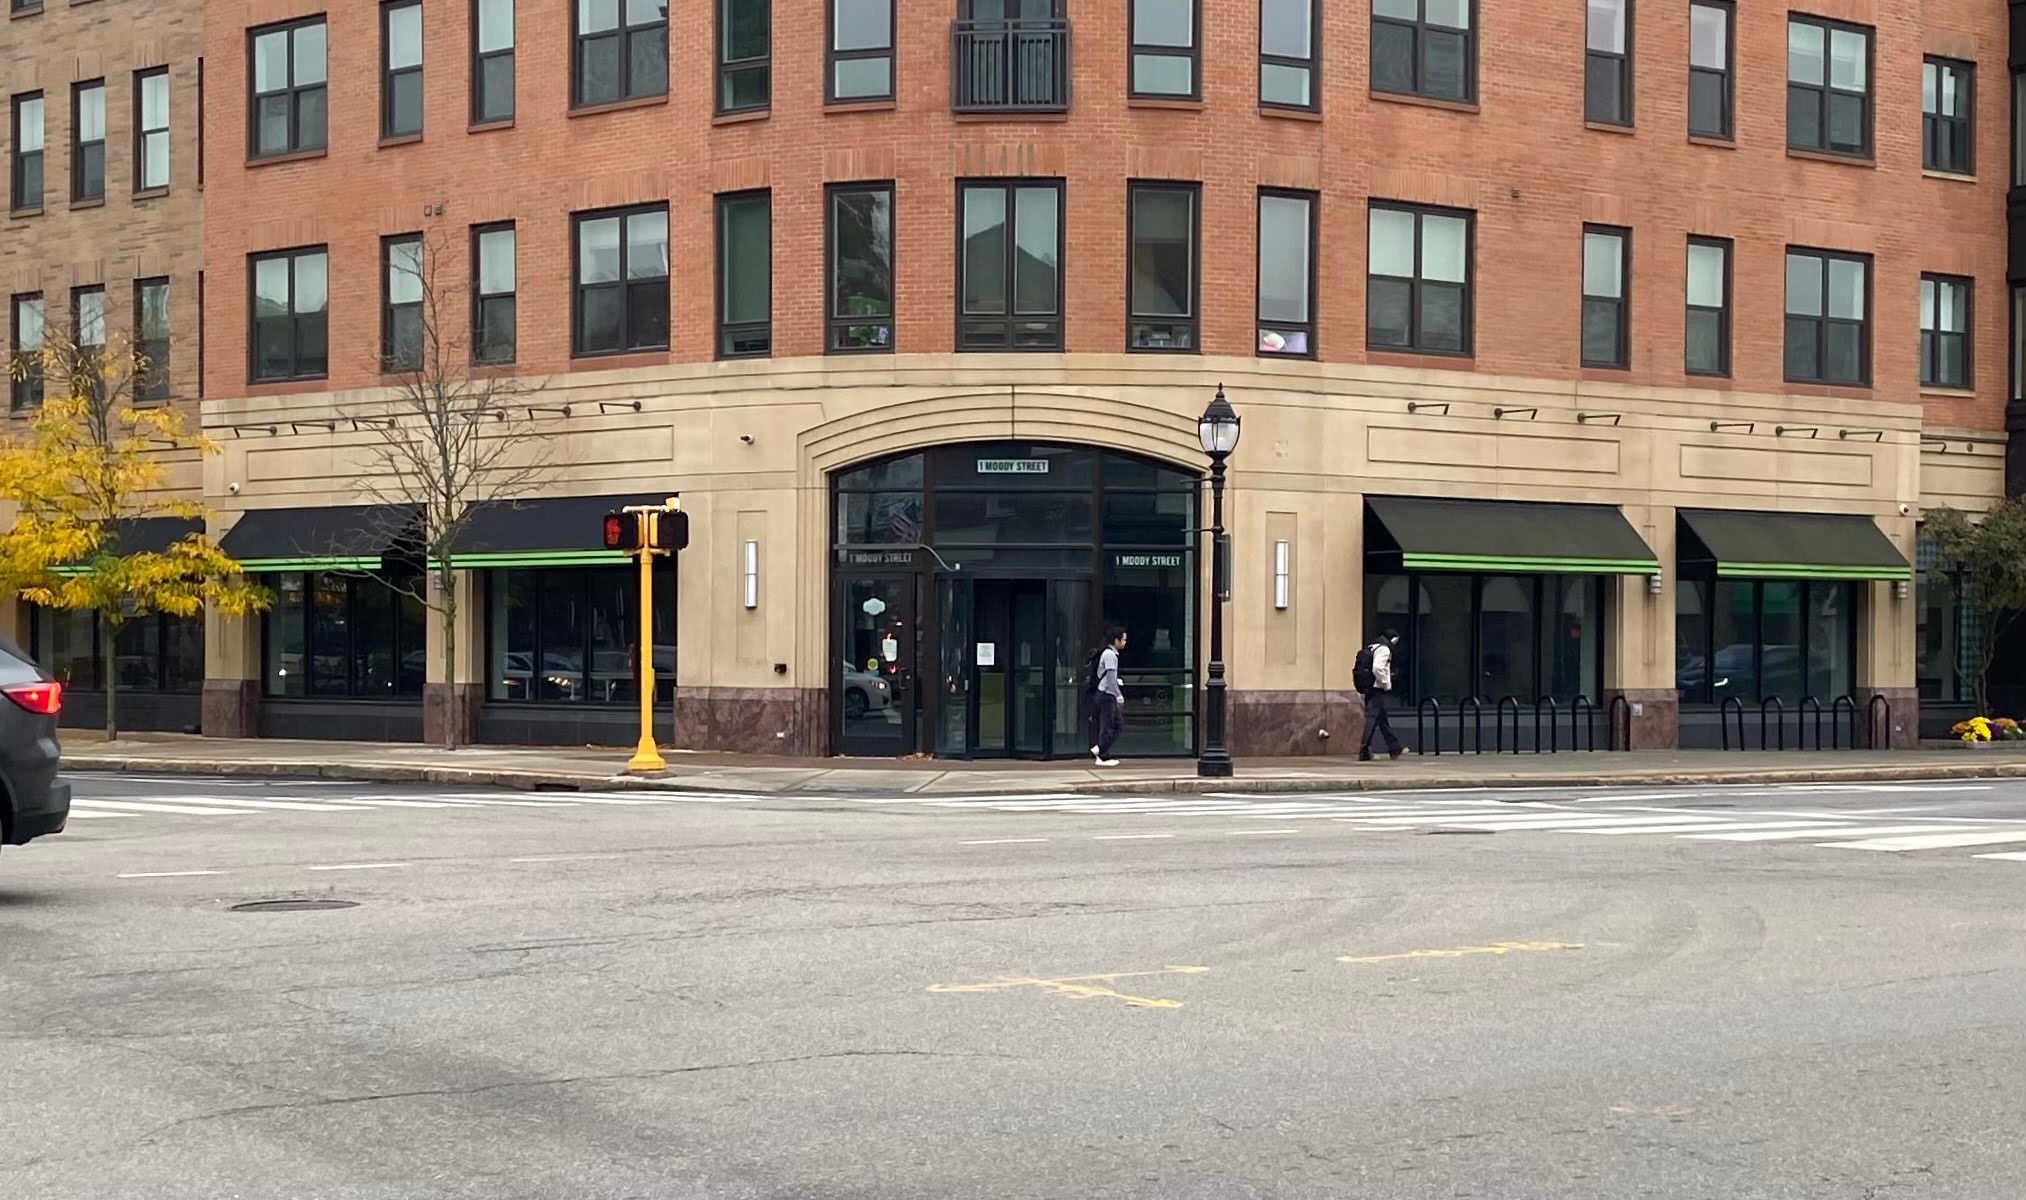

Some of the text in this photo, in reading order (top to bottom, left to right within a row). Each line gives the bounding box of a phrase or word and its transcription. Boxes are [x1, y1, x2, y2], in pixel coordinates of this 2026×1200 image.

[985, 461, 1015, 471] MOODY
[1016, 461, 1047, 471] STREET
[884, 552, 912, 563] STREET
[1122, 555, 1151, 566] MOODY
[1152, 555, 1181, 566] STREET
